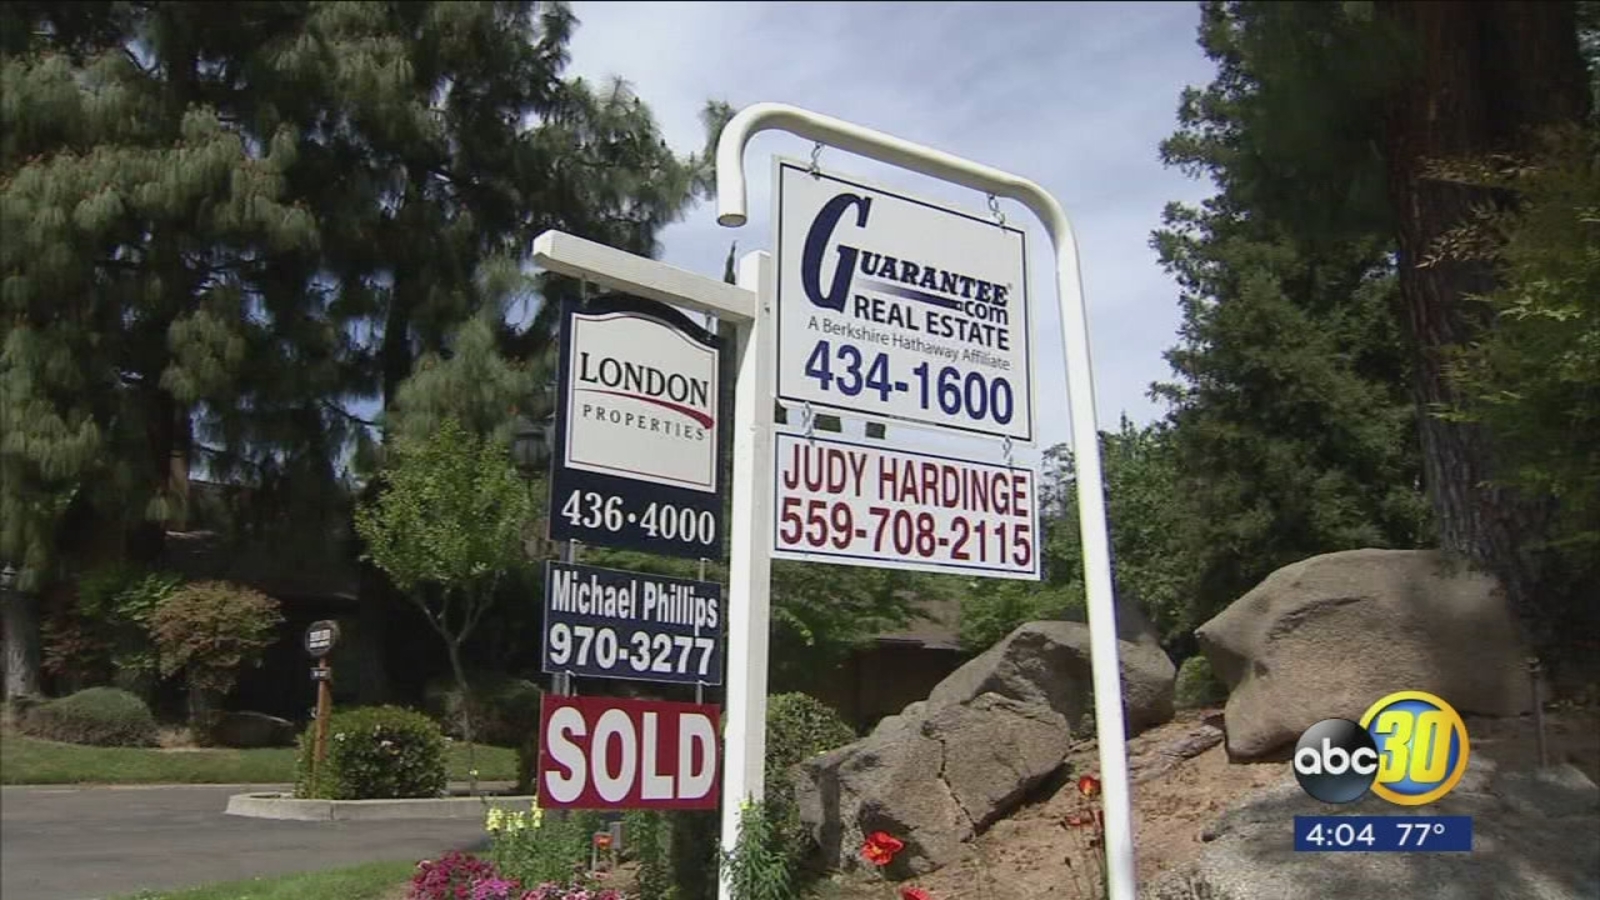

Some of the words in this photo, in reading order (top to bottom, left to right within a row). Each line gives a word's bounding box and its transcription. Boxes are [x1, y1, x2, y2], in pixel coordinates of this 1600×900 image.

[808, 316, 819, 330] A
[823, 319, 889, 346] Berkshire
[892, 330, 959, 361] Hathaway
[962, 348, 1010, 370] Affiliate
[854, 295, 919, 330] REAL
[926, 311, 1009, 350] ESTATE
[579, 352, 709, 407] LONDON
[804, 340, 1014, 425] 434-1600
[583, 405, 705, 441] PROPERTIES
[783, 443, 867, 497] JUDY
[879, 456, 1027, 517] HARDINGE
[780, 497, 1031, 566] 559-708-2115
[552, 569, 636, 620] Michael
[643, 581, 718, 636] Phillips
[549, 623, 715, 675] 970-3277
[545, 706, 716, 802] SOLD
